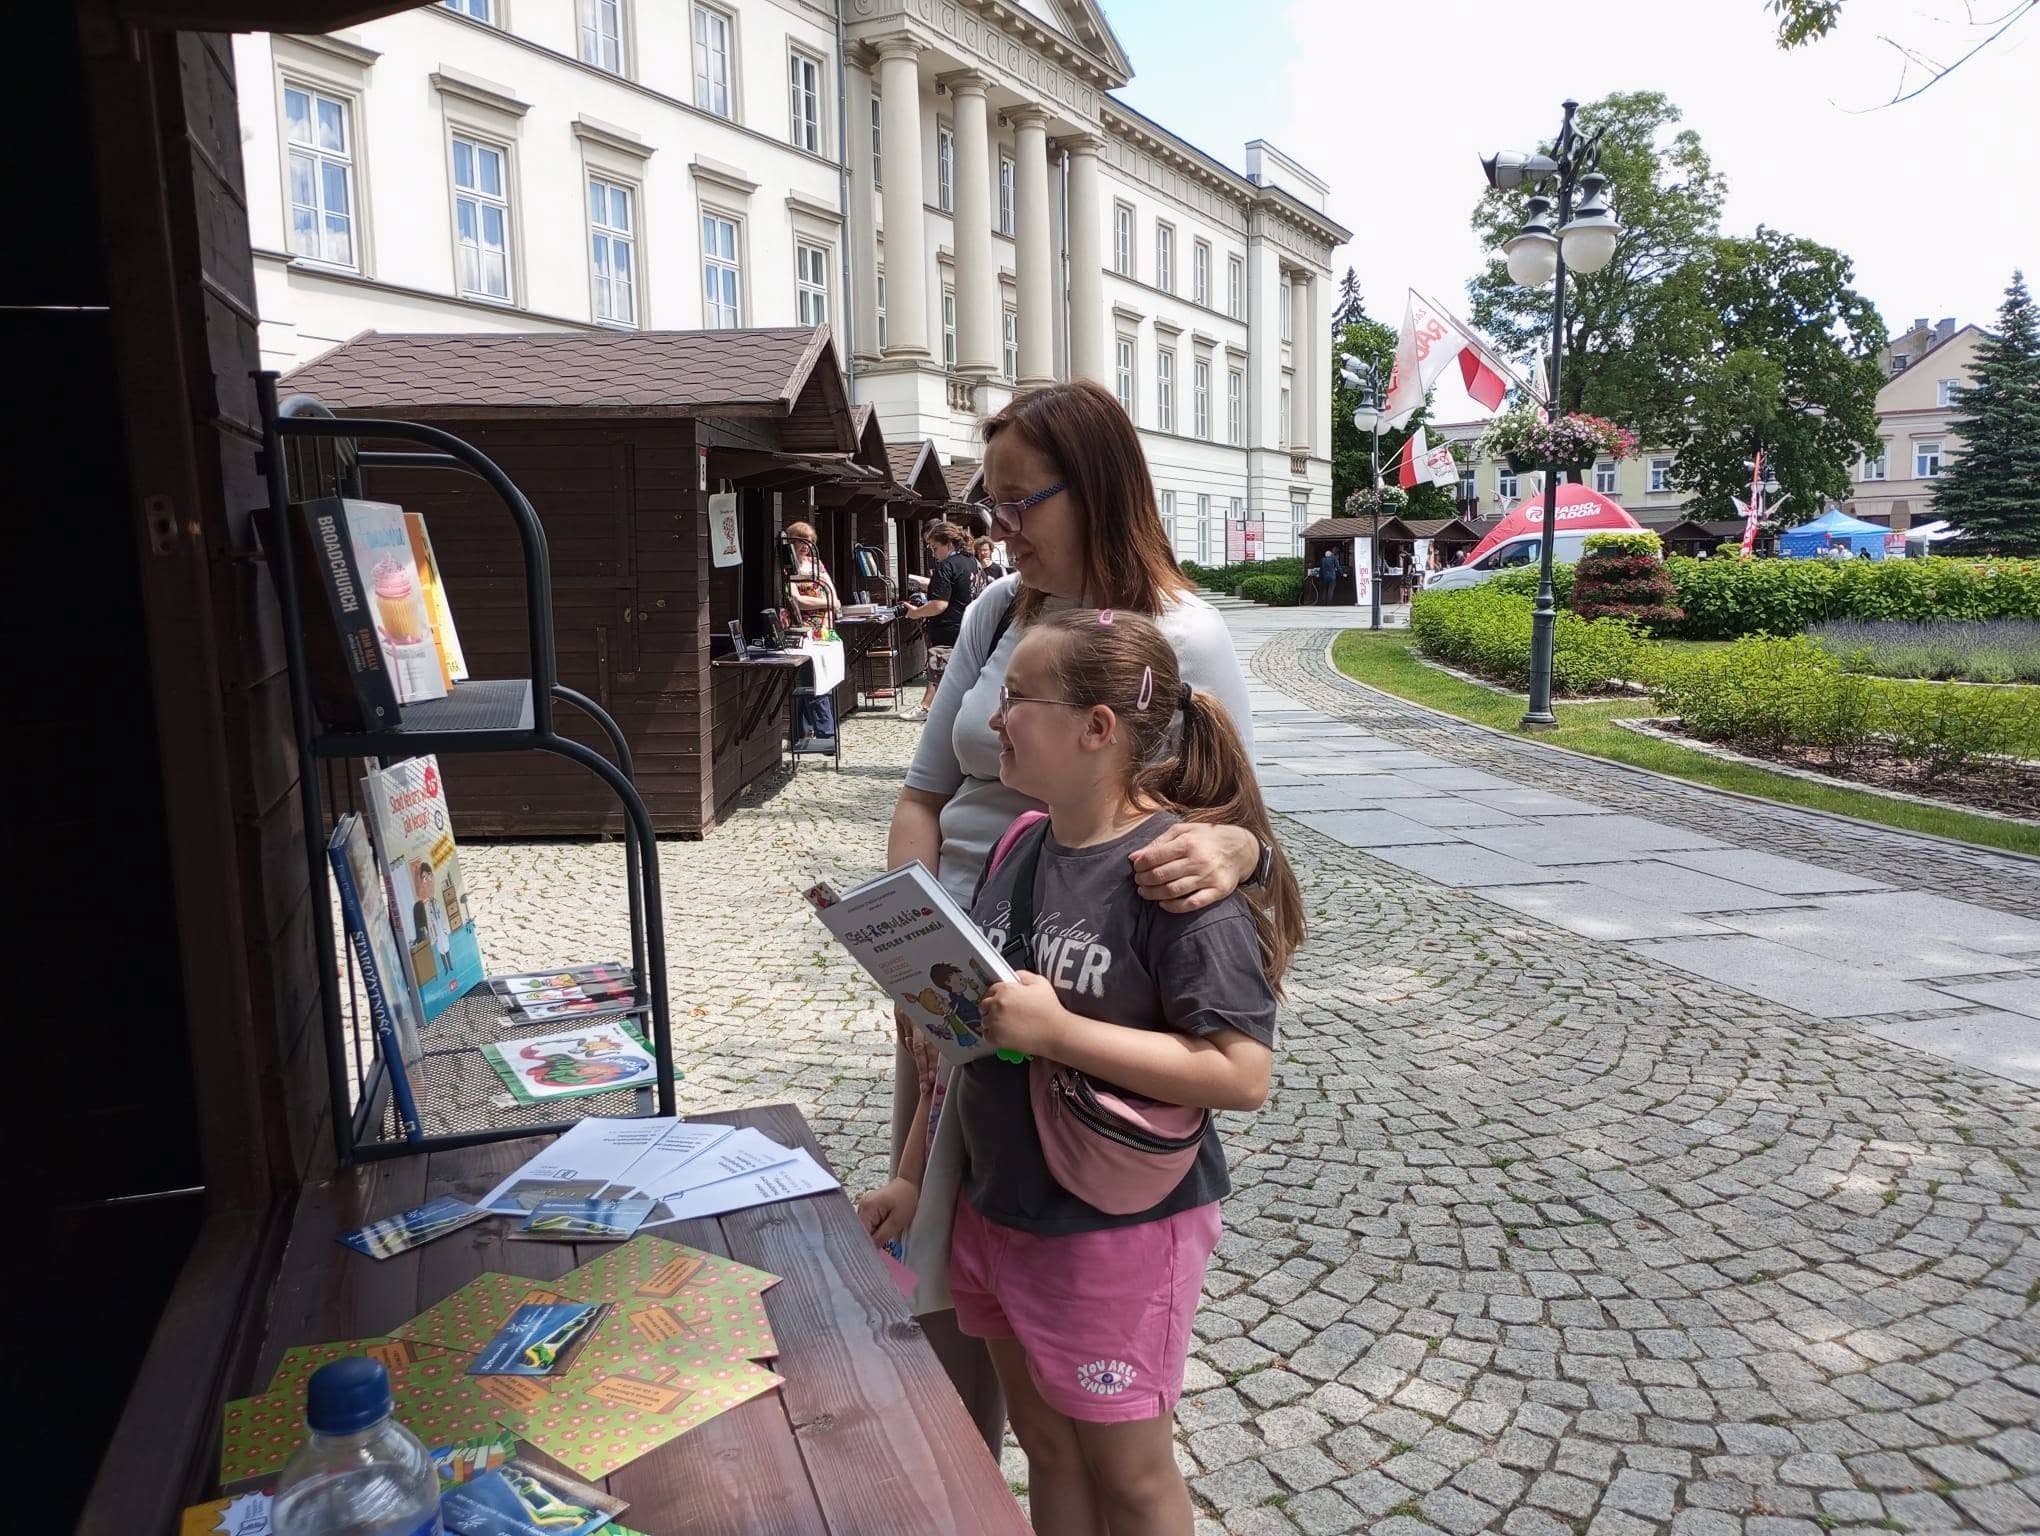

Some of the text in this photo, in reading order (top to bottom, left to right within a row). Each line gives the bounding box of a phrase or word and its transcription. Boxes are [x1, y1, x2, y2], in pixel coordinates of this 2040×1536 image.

[318, 515, 360, 613] BROADCHURCH
[1077, 1359, 1134, 1377] YOU ARE
[1080, 1376, 1133, 1395] ENOUGH
